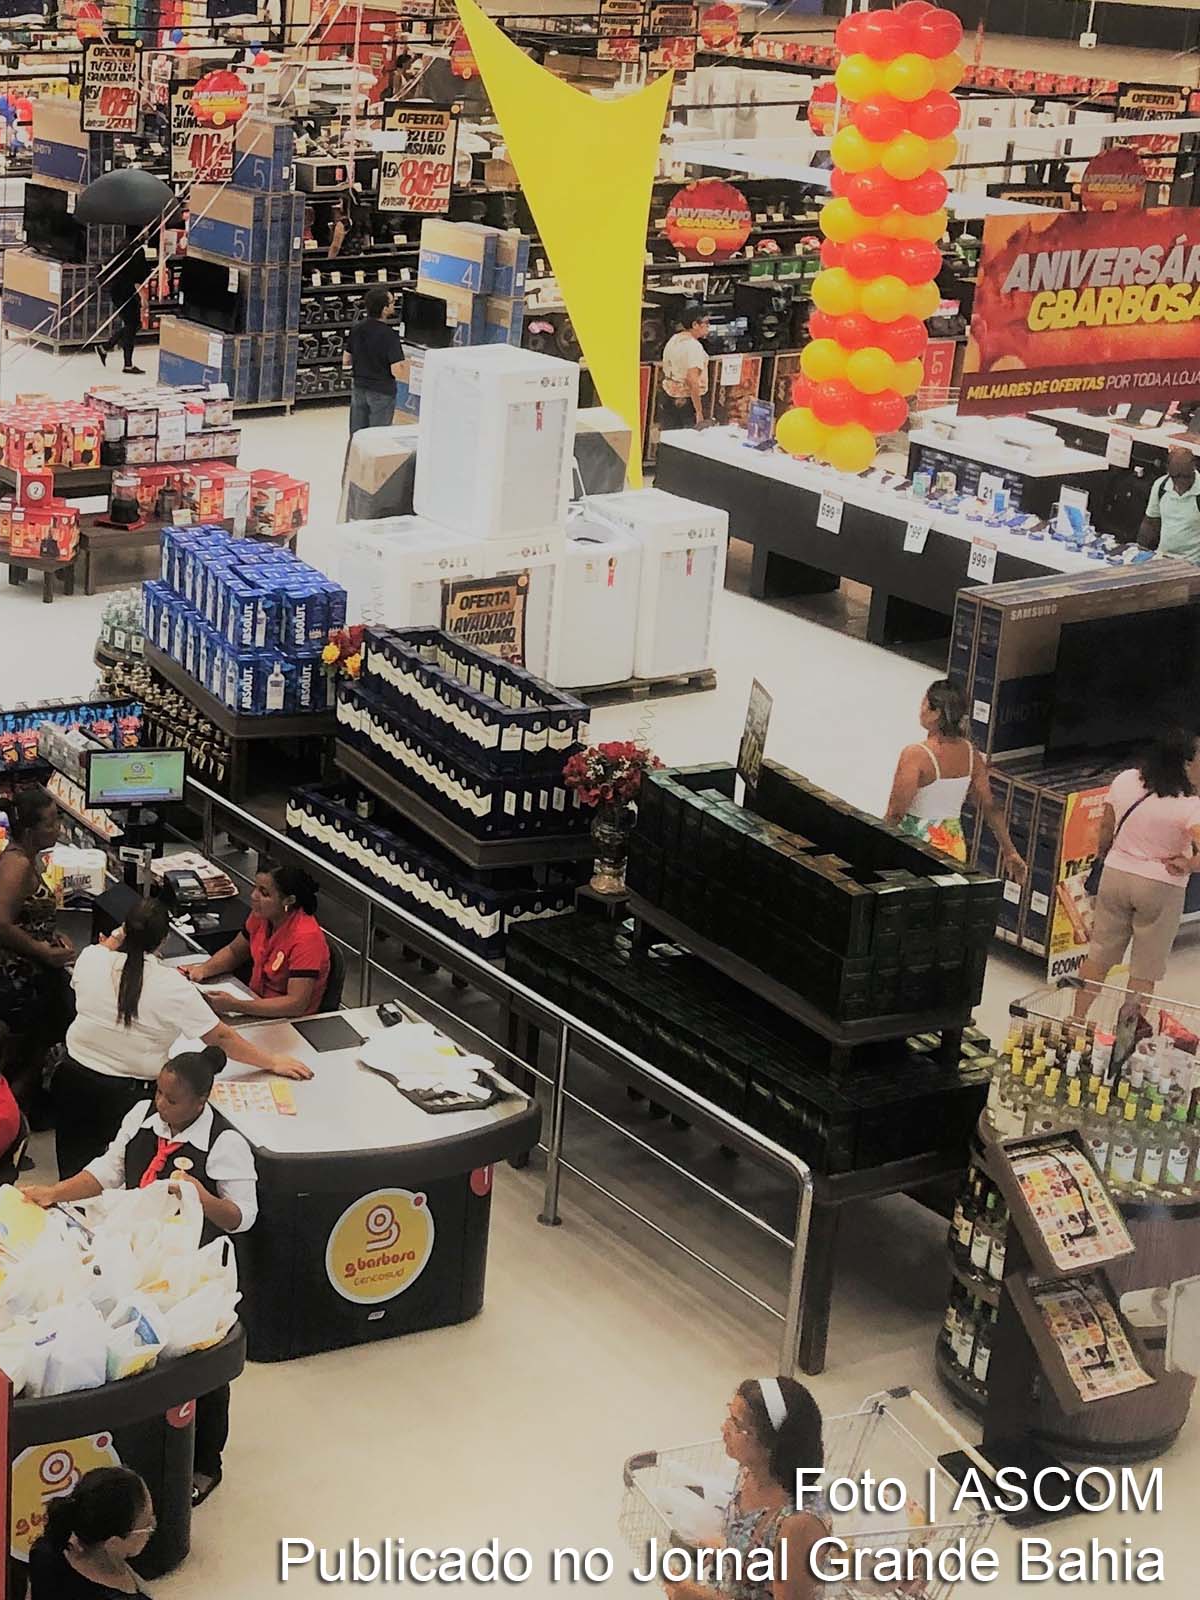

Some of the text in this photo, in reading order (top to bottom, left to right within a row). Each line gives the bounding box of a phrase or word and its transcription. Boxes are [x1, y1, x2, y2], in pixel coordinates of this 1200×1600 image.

[93, 47, 131, 58] OFERTA
[1131, 93, 1176, 106] OFERTA
[398, 112, 445, 125] OFERTA
[420, 130, 445, 143] LED
[253, 158, 265, 191] 5
[667, 207, 752, 219] ANIVERSÁRIO
[232, 228, 246, 261] 5
[461, 263, 473, 288] 4
[453, 325, 464, 346] 4
[930, 350, 946, 375] LG
[967, 370, 1200, 400] MILHARES DE OFERTAS POR TODA A LOJA
[821, 503, 836, 519] 699
[971, 552, 988, 569] 999
[460, 591, 510, 611] OFERTA
[449, 611, 516, 633] LAVADORA
[1010, 604, 1059, 622] SAMSUNG
